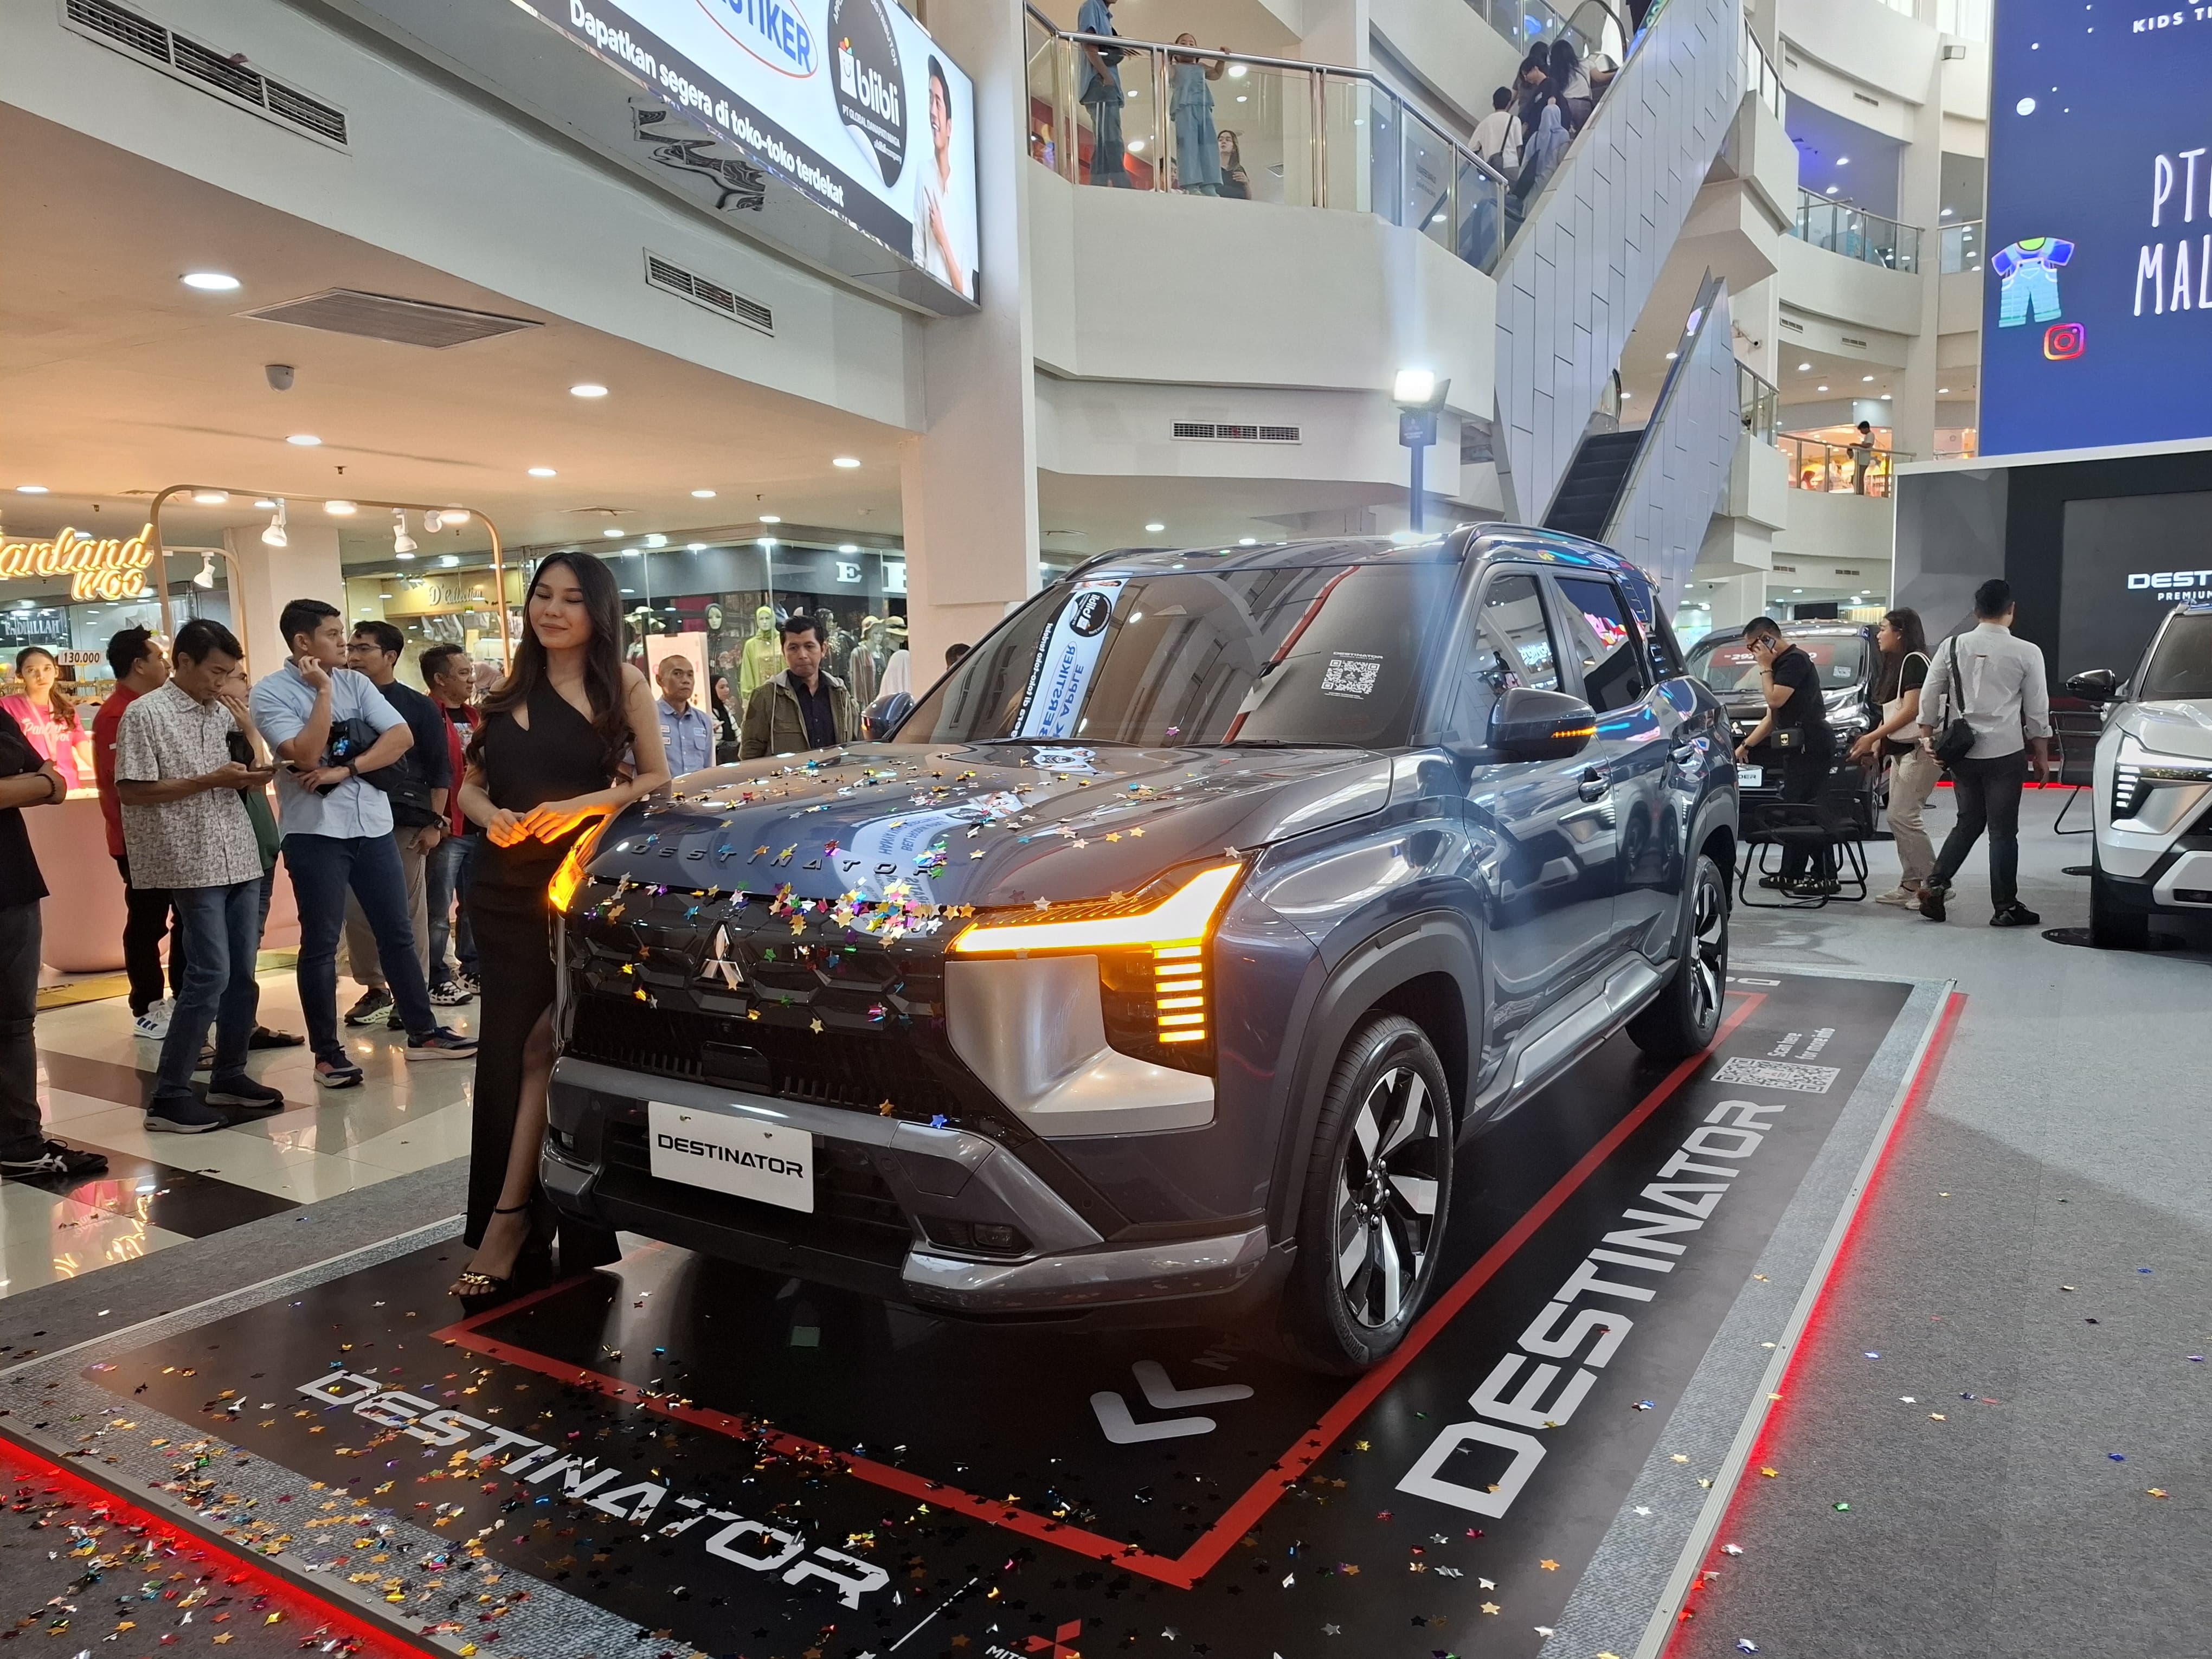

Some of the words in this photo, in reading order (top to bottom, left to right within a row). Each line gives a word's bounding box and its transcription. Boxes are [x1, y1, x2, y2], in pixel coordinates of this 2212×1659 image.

[2133, 11, 2183, 33] KIDS
[570, 0, 657, 79] Dapatkan
[659, 63, 712, 118] segera
[715, 99, 730, 129] di
[731, 109, 795, 173] toko-toko
[796, 156, 845, 207] terdekat
[856, 59, 900, 127] blibli
[2152, 148, 2212, 228] PT
[63, 652, 100, 664] 130.000
[631, 844, 936, 876] DESTINATOR
[1767, 1045, 1793, 1057] Scan
[1776, 1032, 1803, 1047] here
[658, 1133, 804, 1179] DESTINATOR
[1396, 1099, 1786, 1519] DESTINATOR
[295, 1369, 890, 1610] DESTINATOR
